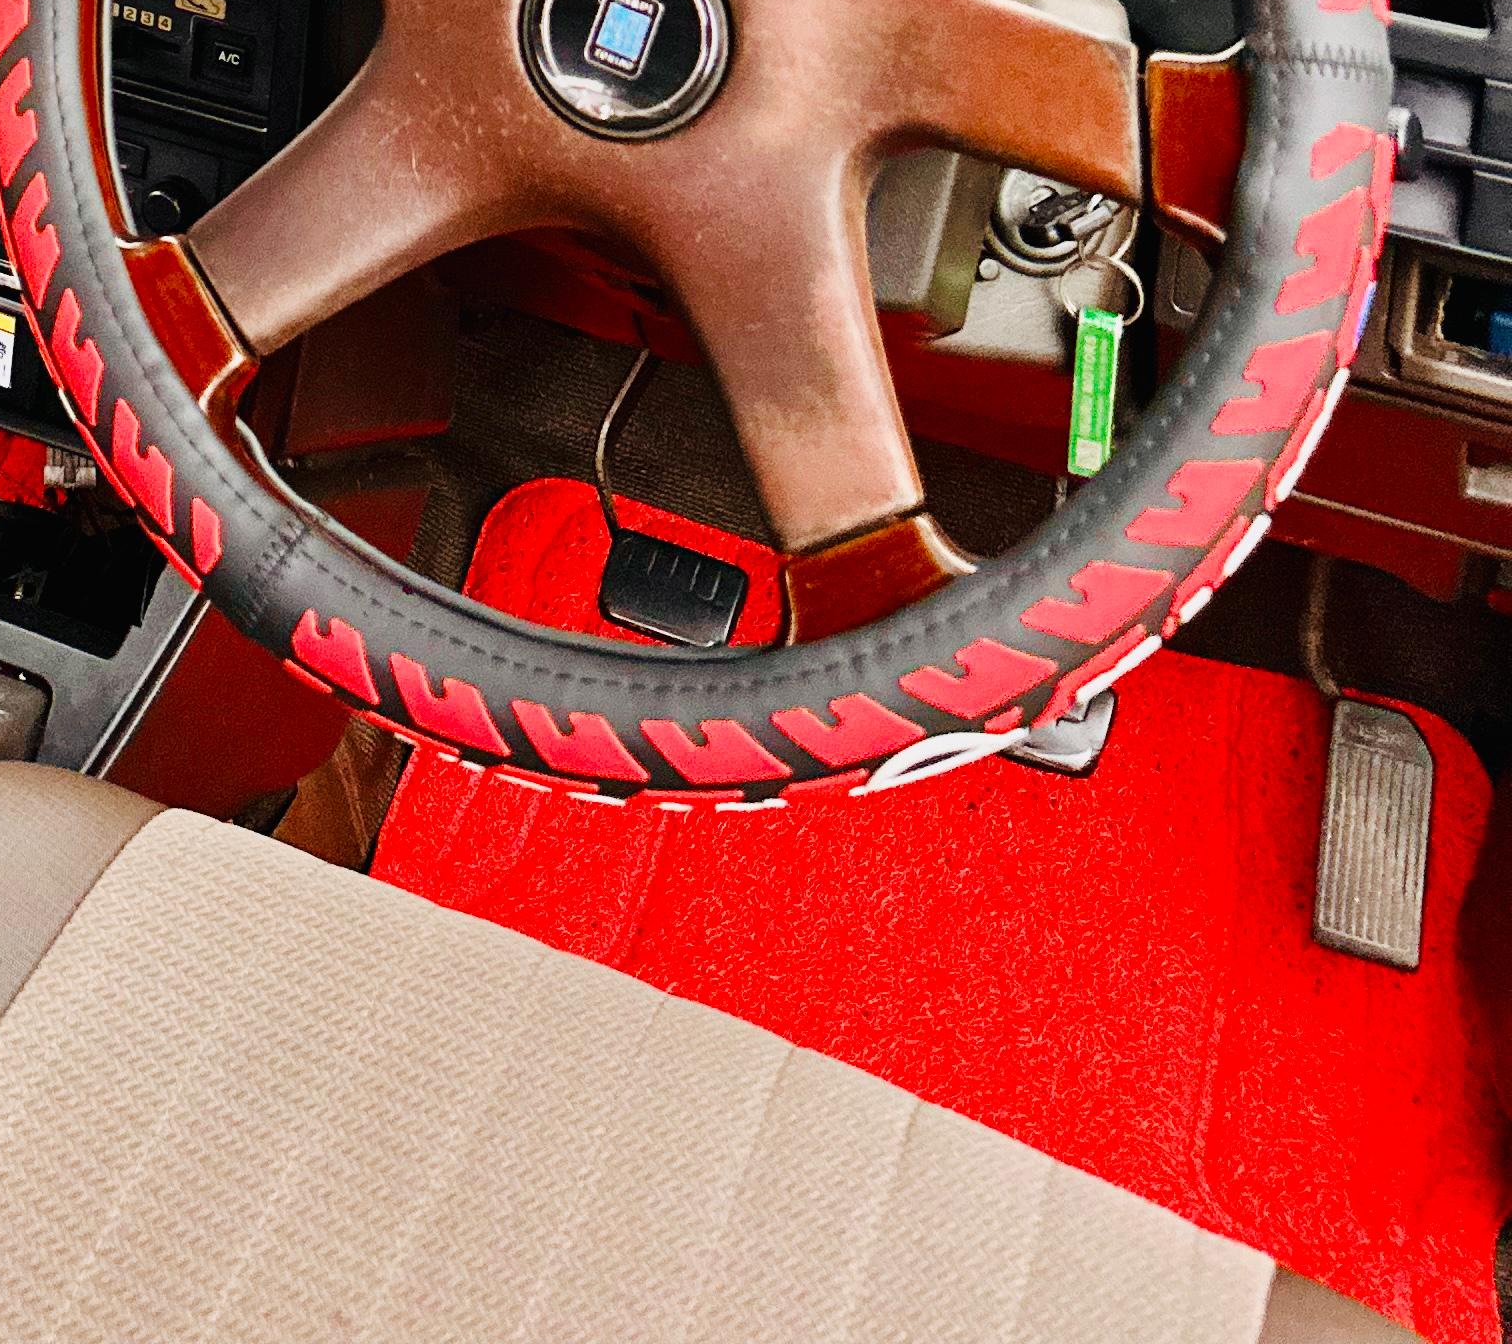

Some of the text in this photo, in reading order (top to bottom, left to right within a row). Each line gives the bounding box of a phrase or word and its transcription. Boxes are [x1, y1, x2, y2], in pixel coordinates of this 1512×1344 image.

[125, 8, 169, 29] 2 3 4
[218, 50, 241, 66] A/C
